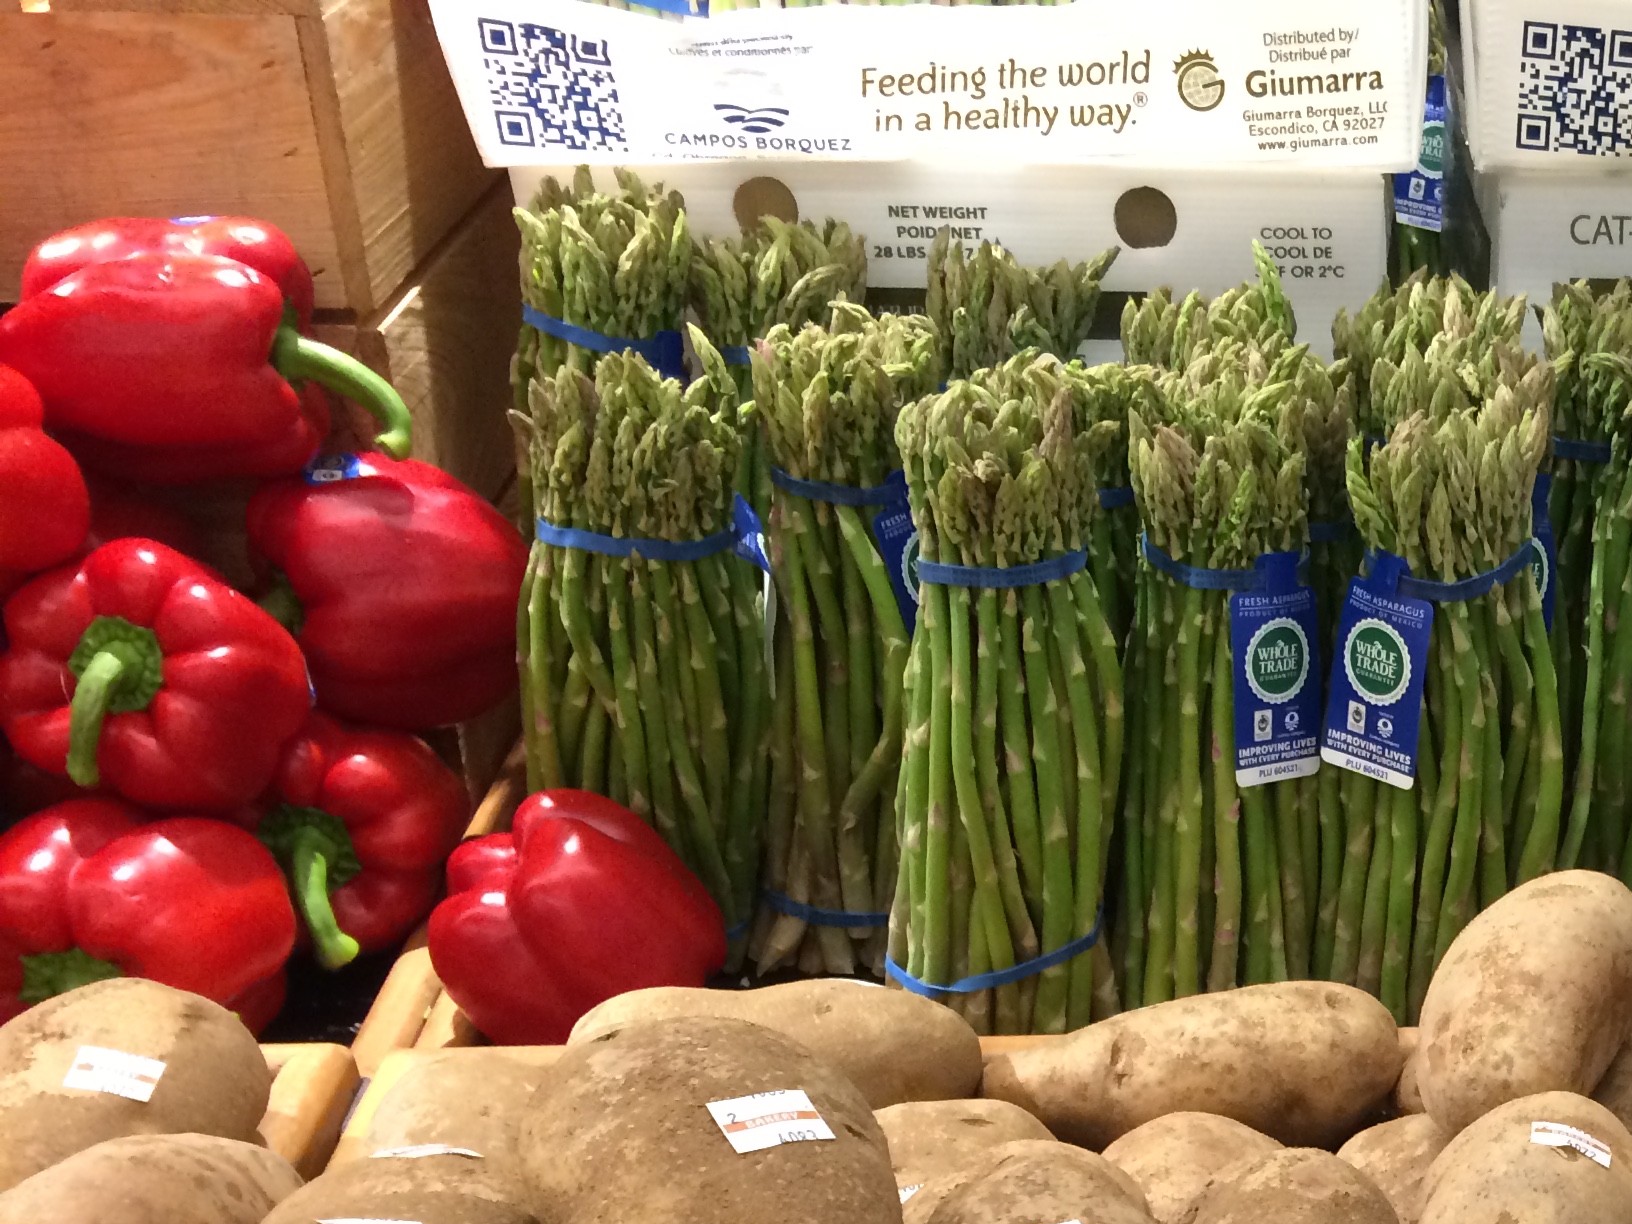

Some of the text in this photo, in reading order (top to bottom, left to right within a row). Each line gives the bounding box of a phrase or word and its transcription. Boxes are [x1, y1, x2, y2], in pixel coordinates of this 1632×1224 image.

[1263, 28, 1335, 47] Distributed
[1269, 46, 1351, 64] Distribué par
[861, 50, 1151, 99] Feeding the world
[1245, 68, 1384, 98] Giumarra
[875, 109, 903, 132] in
[915, 112, 932, 132] a
[943, 97, 1058, 137] healthy
[1242, 109, 1302, 122] Giumarra
[1306, 105, 1364, 121] Borquez,
[1248, 116, 1385, 137] Escondico, CA 92027
[665, 133, 852, 154] CAMPOS BORQUEZ
[1257, 133, 1378, 152] www.giumarra.com
[888, 205, 988, 220] NET WEIGHT
[896, 225, 983, 240] POID NET
[1260, 227, 1333, 240] COOL TO
[873, 245, 894, 259] 28
[1313, 246, 1333, 259] DE
[1290, 265, 1314, 278] OR
[880, 513, 907, 530] FRESH
[1238, 596, 1270, 607] FRESH
[1352, 585, 1426, 619] FRESH ASPARAGUS
[1257, 643, 1298, 661] WHOLE
[1355, 639, 1398, 667] WHOLE
[1259, 657, 1298, 675] TRADE
[1355, 653, 1398, 679] TRADE
[1238, 736, 1317, 759] IMPROVING LIVES
[1326, 738, 1410, 774] WITH EVERY PURCHASE
[1327, 728, 1383, 755] IMPROVING
[1384, 747, 1412, 766] LIVES
[1238, 757, 1258, 767] WITH
[1258, 752, 1280, 764] EVERY
[1345, 758, 1362, 771] PLU
[1259, 768, 1273, 778] PLU
[744, 1110, 799, 1130] BAKERY
